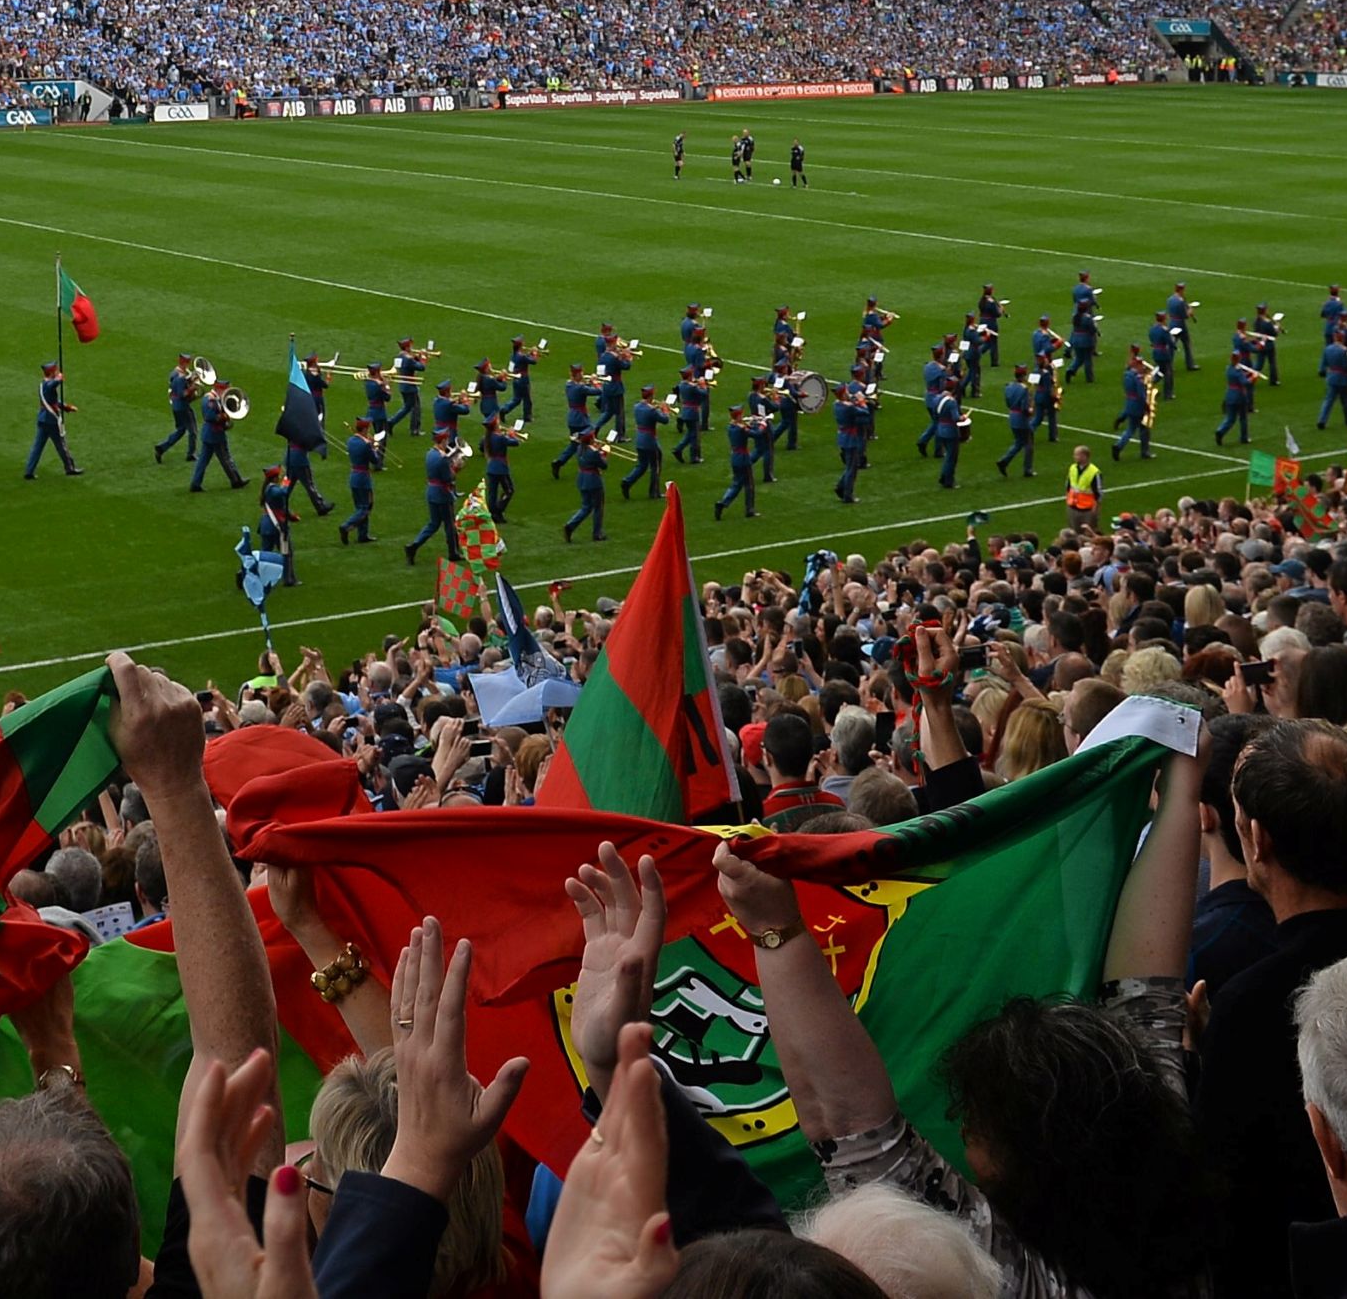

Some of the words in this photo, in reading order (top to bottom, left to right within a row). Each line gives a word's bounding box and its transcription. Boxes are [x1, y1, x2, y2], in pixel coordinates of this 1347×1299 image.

[843, 83, 873, 94] eircom
[920, 79, 937, 93] AIB
[957, 78, 974, 91] AIB
[992, 77, 1009, 90] AIB
[1027, 76, 1044, 89] AIB
[639, 90, 680, 101] SuperValu
[723, 87, 756, 98] eircom
[763, 86, 796, 97] eircom
[804, 84, 835, 95] eircom
[505, 94, 547, 106] SuperValu
[551, 92, 592, 104] SuperValu
[596, 92, 636, 103] SuperValu
[283, 101, 307, 117] AIB
[334, 100, 357, 115] AIB
[384, 98, 406, 113] AIB
[433, 97, 455, 112] AIB
